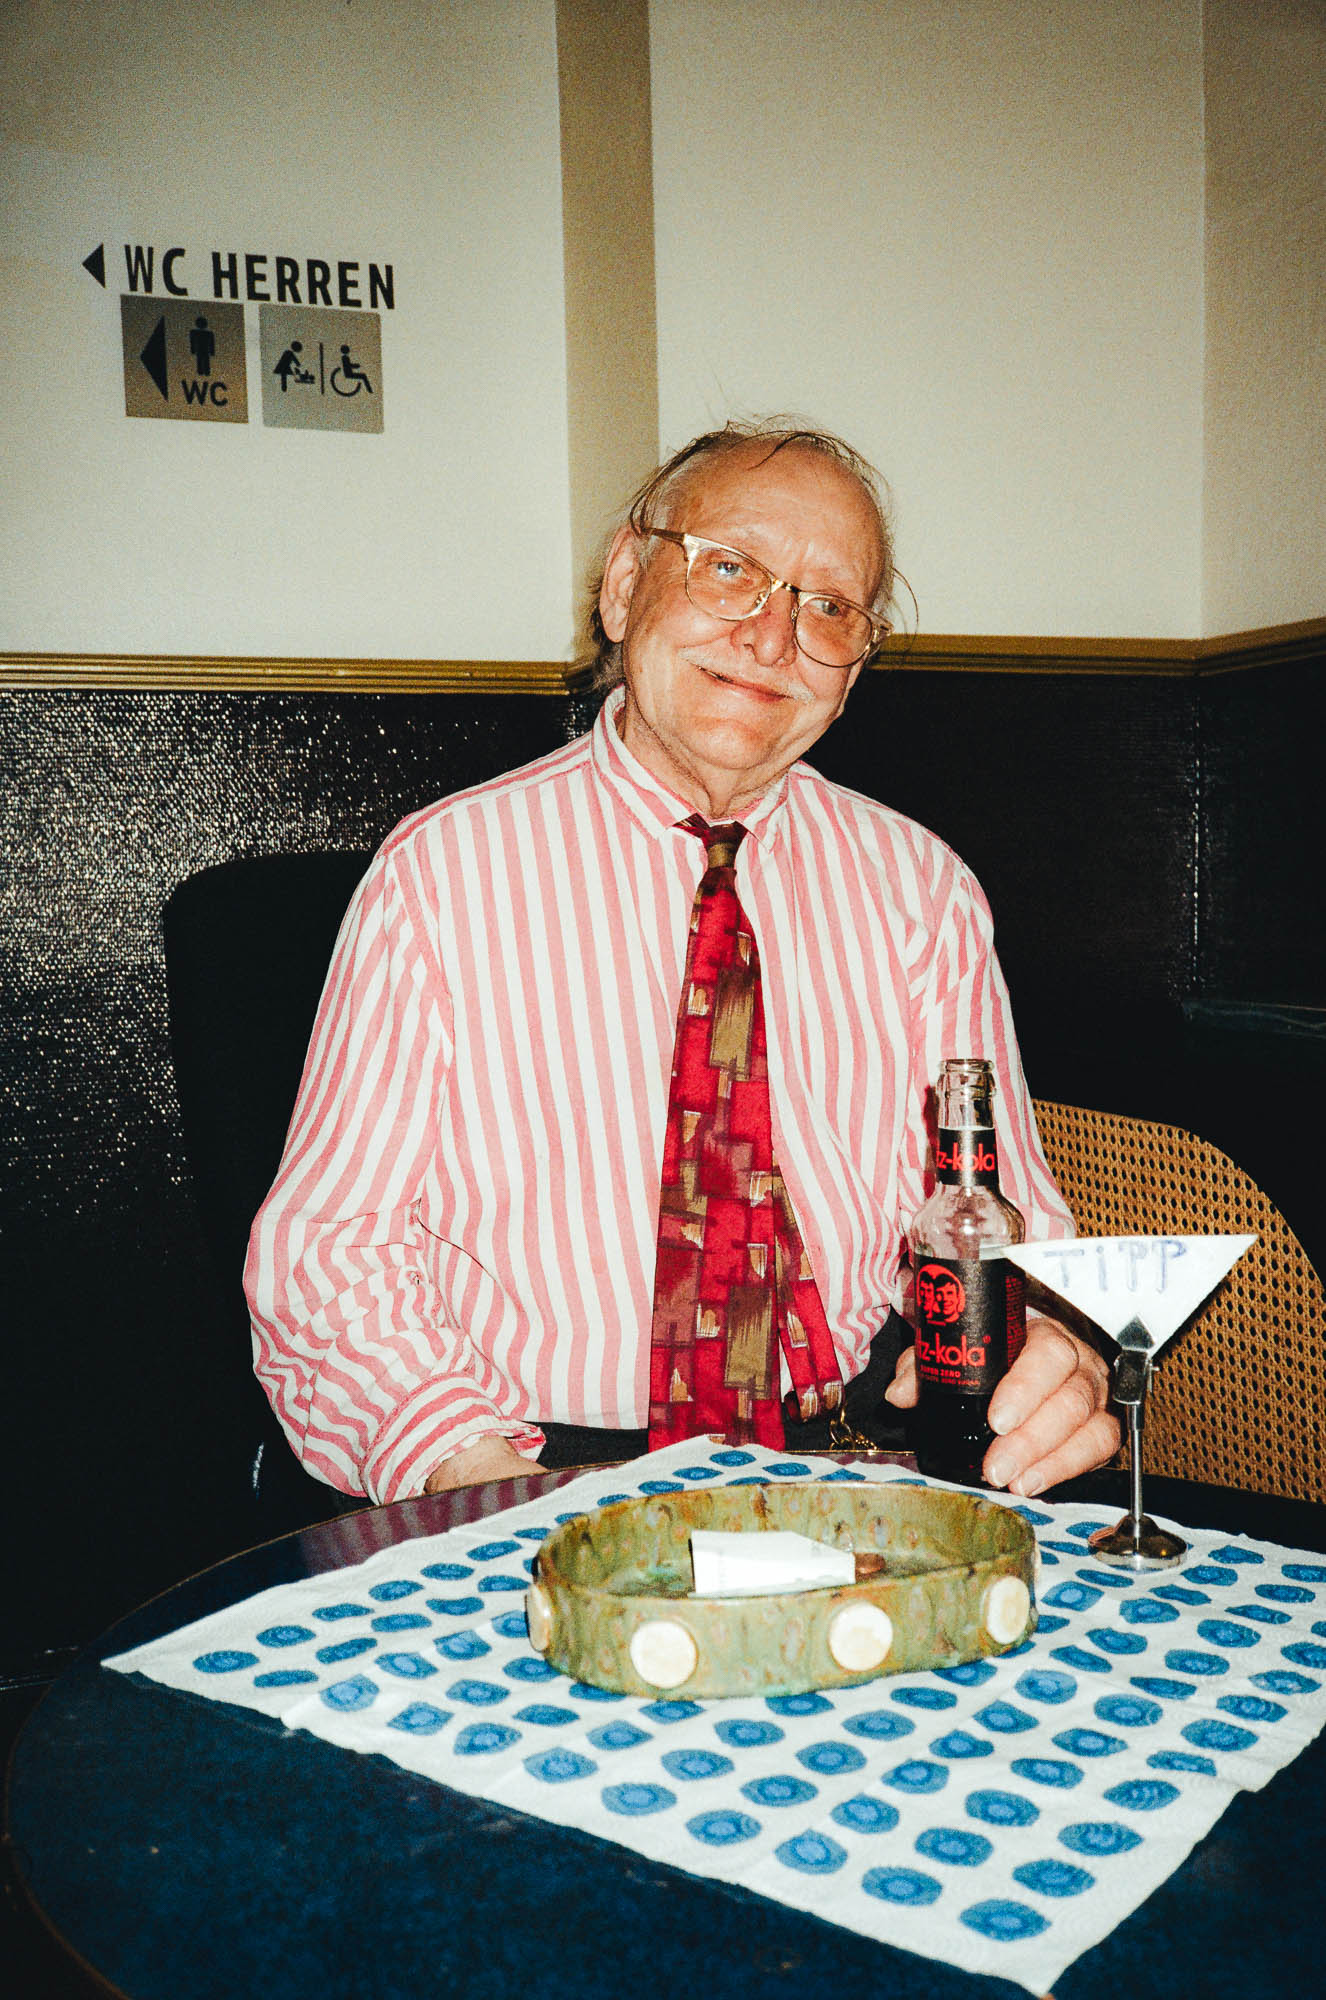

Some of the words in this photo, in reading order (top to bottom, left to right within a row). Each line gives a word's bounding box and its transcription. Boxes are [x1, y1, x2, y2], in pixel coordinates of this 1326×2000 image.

[124, 244, 189, 296] WC
[212, 251, 395, 310] HERREN
[181, 379, 229, 407] WC
[936, 1142, 996, 1172] z-kola
